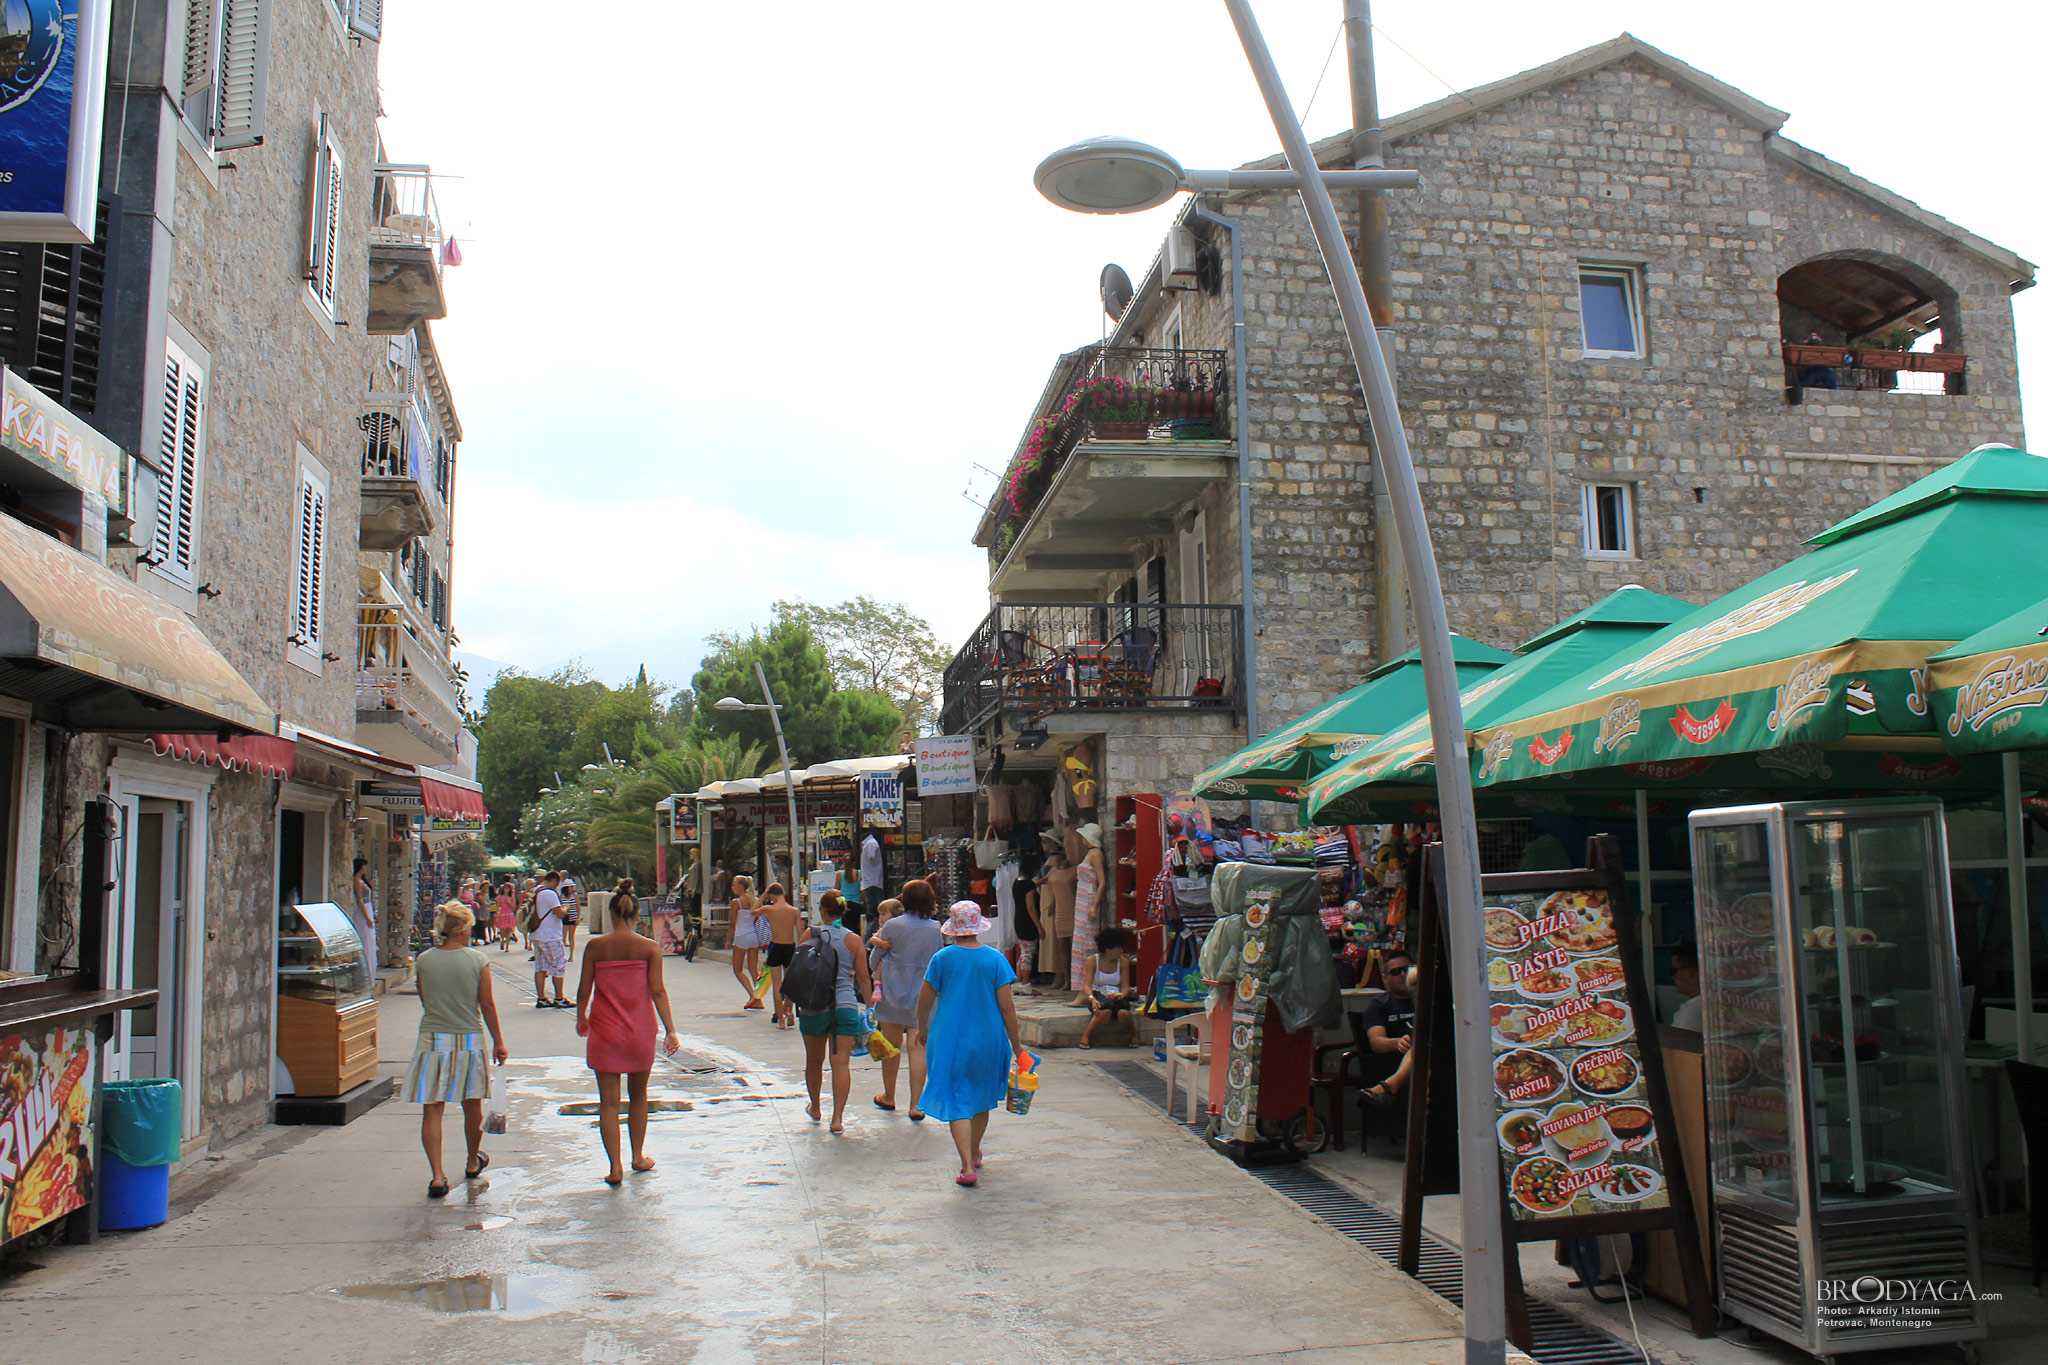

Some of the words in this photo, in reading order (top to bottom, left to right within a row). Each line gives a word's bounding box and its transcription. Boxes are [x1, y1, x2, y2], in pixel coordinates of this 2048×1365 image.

[2, 391, 121, 502] KAFANA
[1697, 714, 1721, 740] 1896
[1991, 711, 2022, 737] PIVO
[921, 750, 969, 760] Boutique
[921, 762, 970, 773] Boutique
[863, 779, 900, 798] MARKET
[922, 775, 971, 788] Boutique
[750, 801, 812, 816] ПАРИКМХЕР
[432, 832, 470, 852] ZLATAR
[1519, 911, 1570, 942] PIZZA
[1510, 947, 1567, 981] PAŠTE
[1579, 973, 1613, 991] lazanje
[1527, 996, 1592, 1030] DORUČAK
[1566, 1026, 1593, 1043] omlet
[1576, 1048, 1623, 1074] PEČENJE
[1509, 1076, 1550, 1100] ROŠTILJ
[0, 1067, 60, 1184] RILL
[1542, 1114, 1582, 1136] KUVANA
[1584, 1105, 1607, 1124] JELA
[1516, 1142, 1533, 1153] supe
[1557, 1163, 1610, 1195] SALATE
